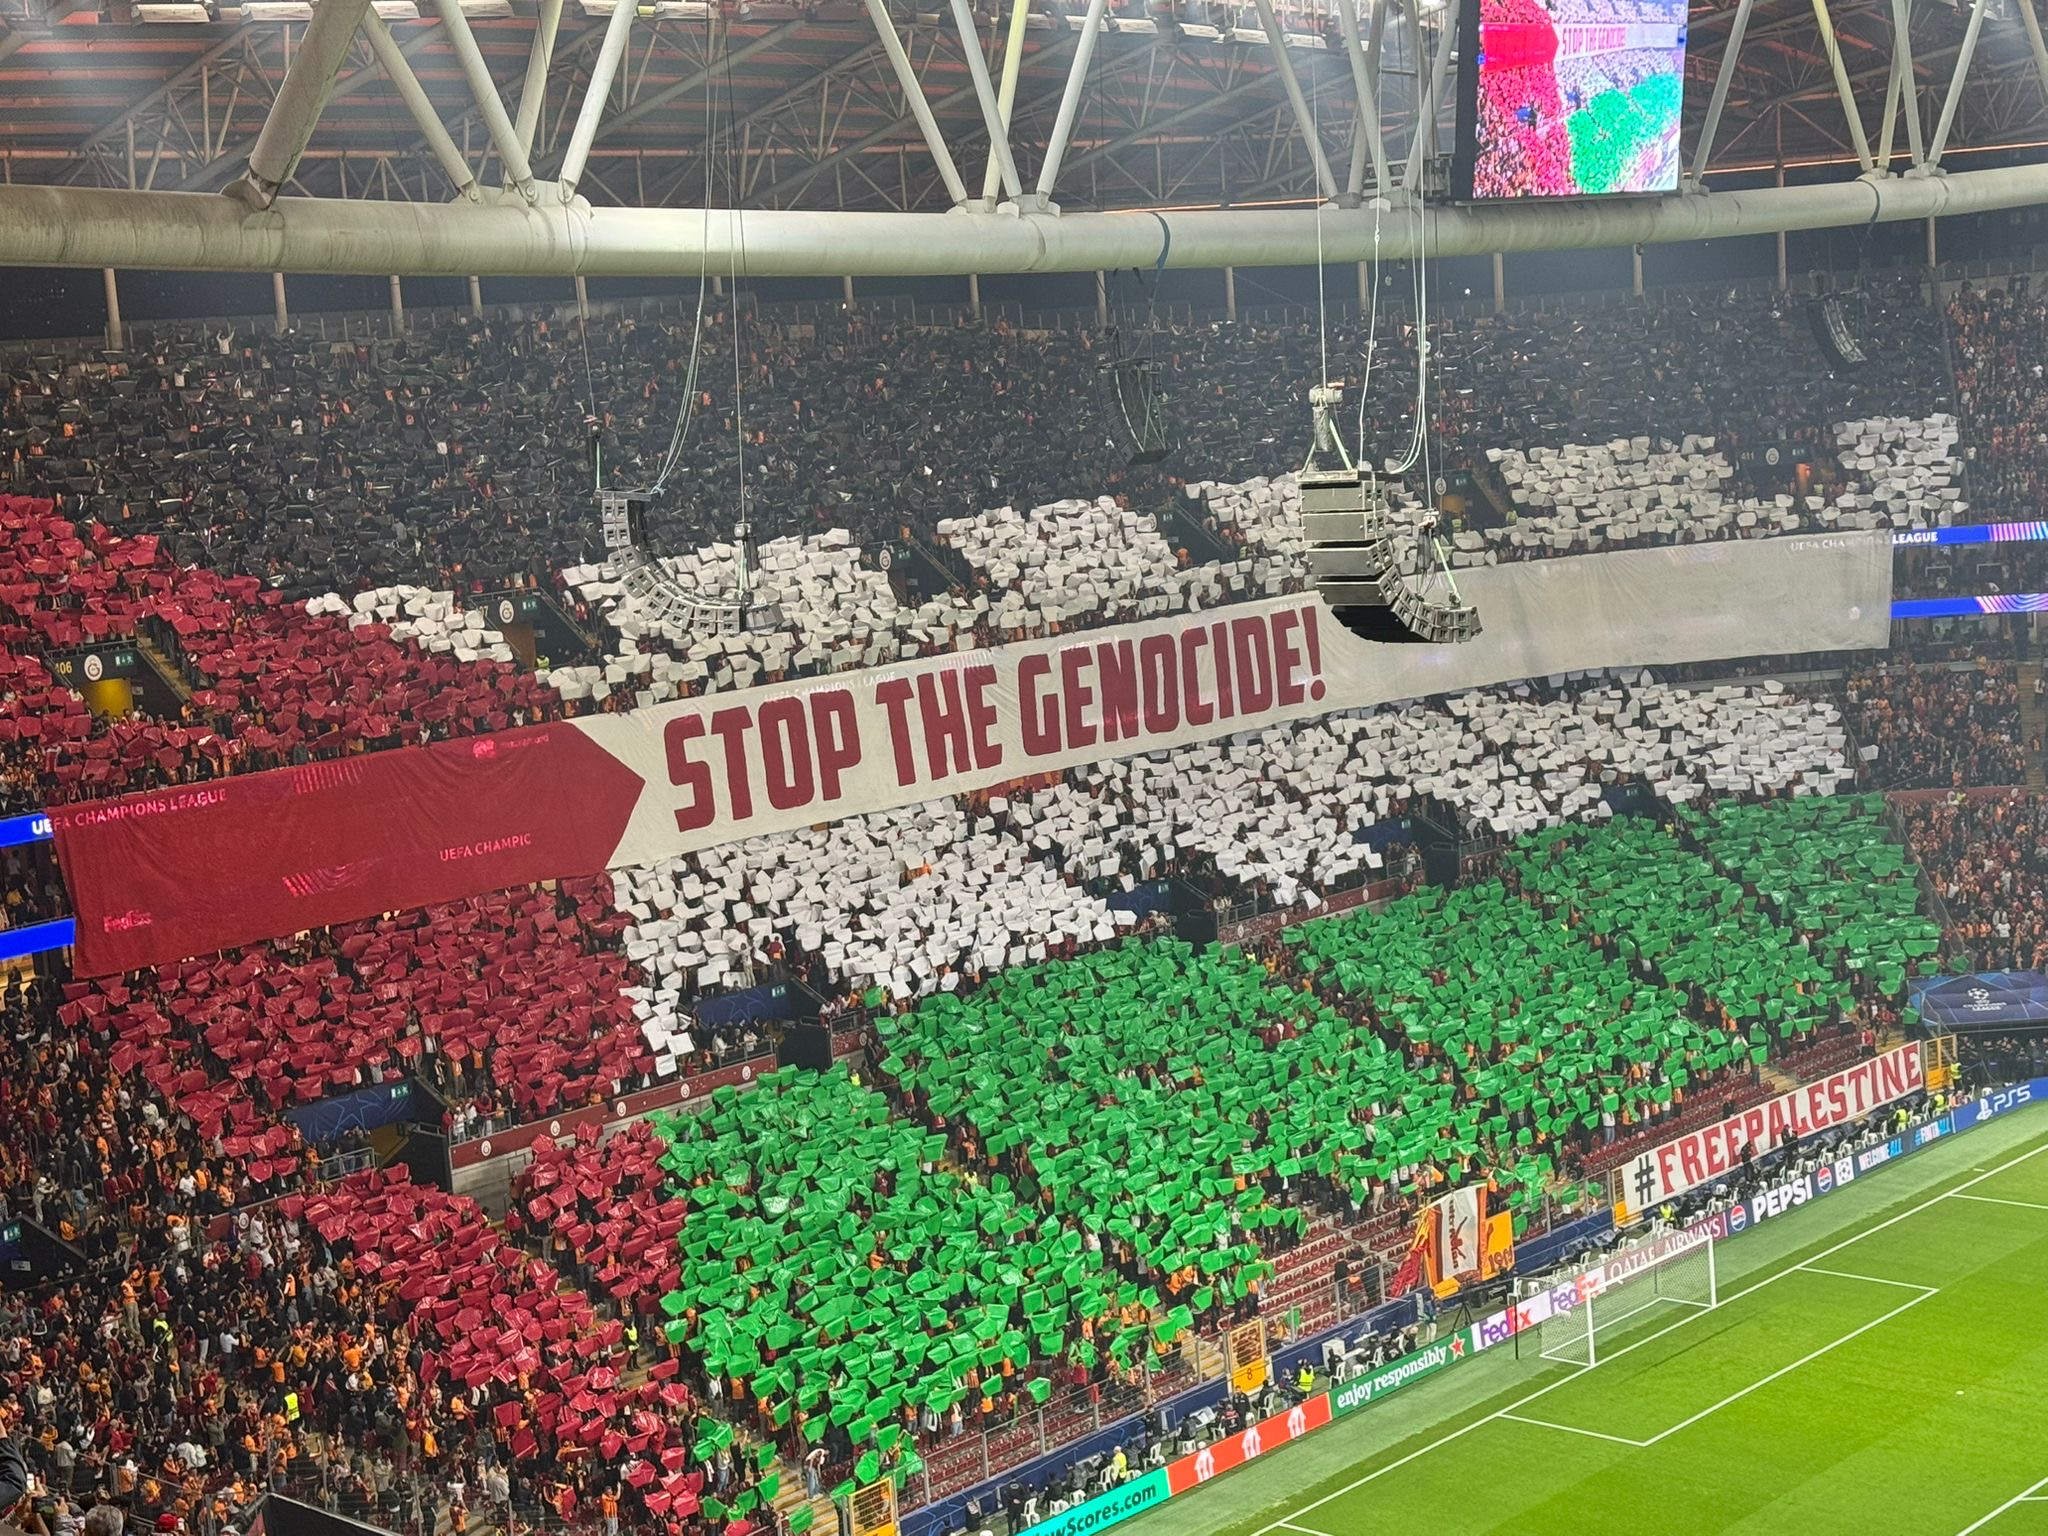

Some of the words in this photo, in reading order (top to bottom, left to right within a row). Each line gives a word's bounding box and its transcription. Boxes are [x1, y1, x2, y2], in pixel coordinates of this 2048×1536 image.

[1893, 531, 1939, 544] LEAGUE
[664, 690, 861, 833] STOP
[876, 667, 1002, 786] THE
[1018, 605, 1327, 756] GENOCIDE!
[32, 816, 71, 835] UEFA
[75, 801, 167, 827] CHAMPIONS
[170, 788, 228, 811] LEAGUE
[440, 845, 473, 861] UEFA
[1993, 1085, 2031, 1112] PS5
[1634, 1044, 1922, 1205] #FREEPALESTINE
[1752, 1174, 1814, 1224] PEPSI
[1664, 1218, 1721, 1257] AIRWAYS
[1479, 1306, 1532, 1347] FedEx
[1337, 1379, 1373, 1408] enjoy
[1374, 1346, 1447, 1391] responsibly
